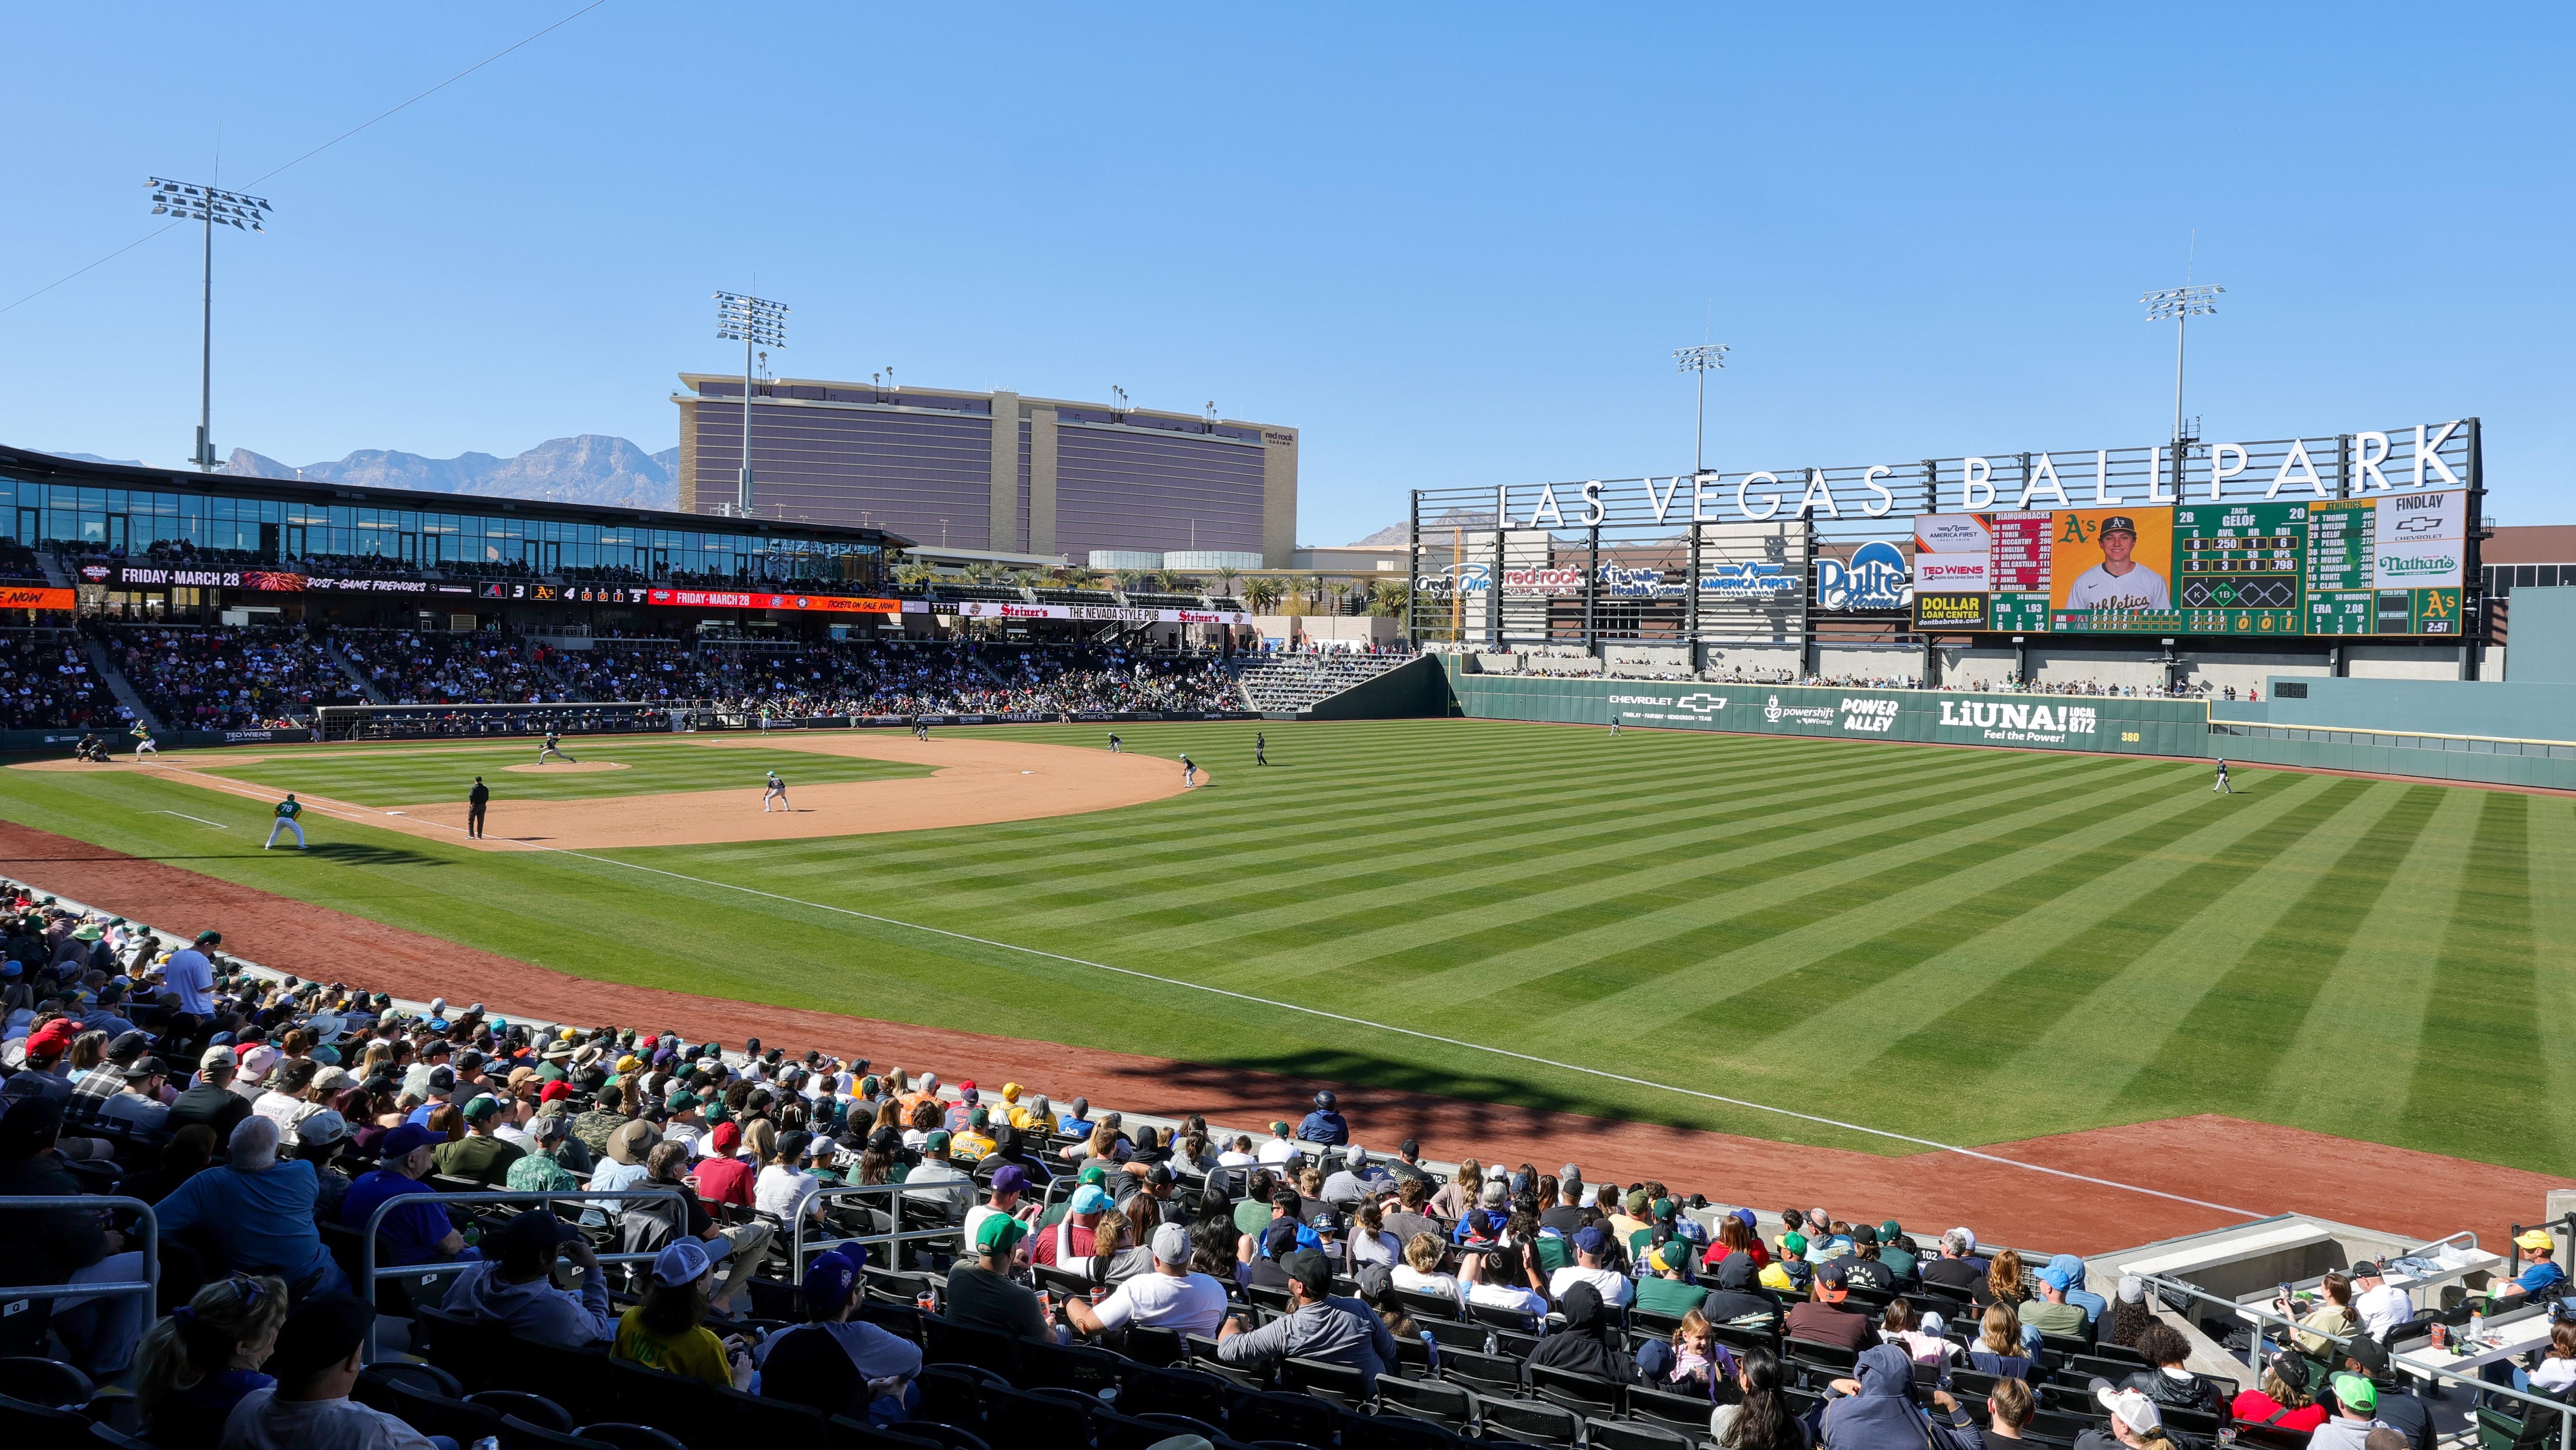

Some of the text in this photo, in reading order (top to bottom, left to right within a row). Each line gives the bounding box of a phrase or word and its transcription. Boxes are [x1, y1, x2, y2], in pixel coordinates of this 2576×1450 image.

[1500, 419, 2464, 530] LAS VEGAS BALLPARK
[2326, 500, 2362, 510] ATHLETICS
[2396, 494, 2444, 511] FINDLAY
[1996, 512, 2050, 520] DIAMONDBACKS
[2179, 511, 2194, 523] 2B
[2289, 508, 2305, 519] 20
[2322, 514, 2348, 522] THOMAS
[2111, 517, 2125, 528] A's
[2222, 515, 2256, 526] GELOF
[2057, 514, 2096, 544] A's
[2215, 539, 2237, 549] .250
[2272, 560, 2293, 570] .798
[2379, 555, 2457, 572] Nathan's
[1505, 565, 1582, 584] red rock
[1612, 569, 1662, 584] The Valley
[1922, 565, 1984, 576] TED WIENS
[223, 573, 240, 586] 28
[307, 577, 371, 591] POST-GAME
[372, 580, 427, 592] FIREWORKS
[1459, 574, 1492, 591] One
[1700, 577, 1798, 589] AMERICA FIRST
[1814, 559, 1905, 604] Pulte
[513, 585, 524, 598] 3
[534, 586, 554, 599] A's
[564, 587, 575, 600] 4
[1612, 584, 1684, 599] Health System
[1829, 585, 1903, 610] Homes
[8, 592, 43, 604] NOW
[633, 594, 641, 603] 5
[739, 595, 750, 606] 28
[1922, 598, 1979, 610] DOLLAR
[2421, 590, 2455, 618] A's
[827, 600, 851, 609] TICKETS
[878, 602, 895, 610] NOW
[1996, 604, 2042, 612] ERA 1.93
[2313, 604, 2364, 613] ERA 2.08
[999, 603, 1220, 623] Steiner's THE NEVADA STYLE PUB Steiner's
[2427, 622, 2448, 633] 2:51
[1609, 695, 1673, 705] CHEVROLET
[1783, 707, 1834, 718] powershift
[1841, 698, 1899, 717] POWER
[2069, 707, 2095, 719] LOCAL
[1940, 700, 2067, 732] LiUNA!
[1844, 714, 1893, 732] ALLEY
[2069, 718, 2095, 733] 872
[1984, 729, 2065, 743] Feel the Power!
[2121, 732, 2140, 742] 380
[281, 805, 293, 813] 78
[954, 1140, 986, 1154] CHAPMAN
[1921, 1250, 1937, 1261] 102
[1845, 1266, 1877, 1288] ARHARTT
[13, 1303, 20, 1312] Q
